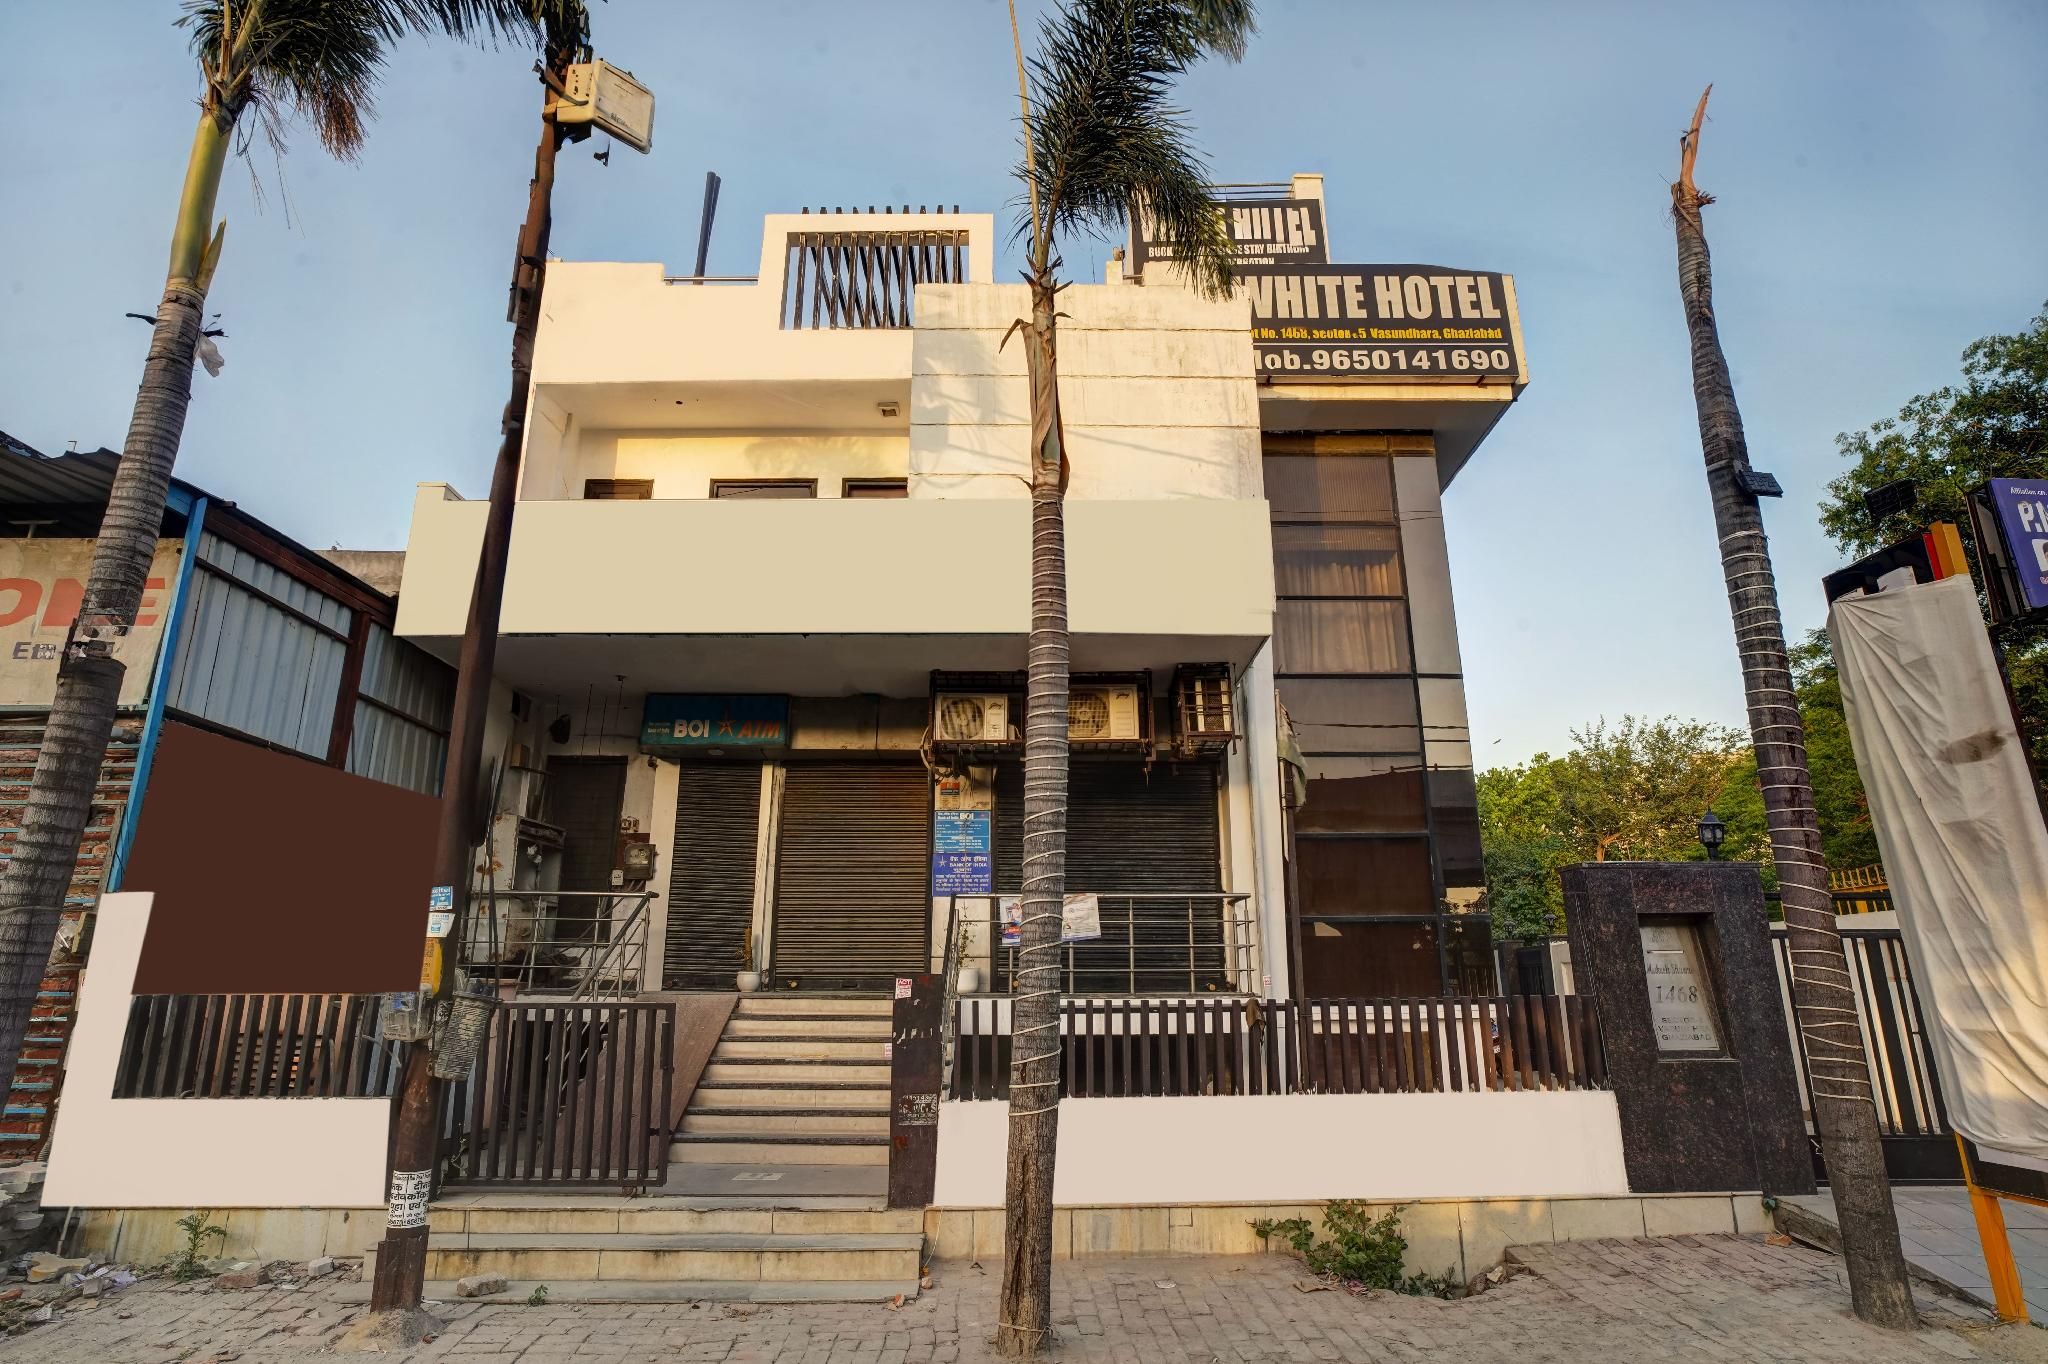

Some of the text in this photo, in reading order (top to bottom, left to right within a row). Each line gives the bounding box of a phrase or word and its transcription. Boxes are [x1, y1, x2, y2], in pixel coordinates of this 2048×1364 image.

[1243, 243, 1265, 254] STAY
[1374, 275, 1501, 319] HOTEL
[1261, 328, 1278, 339] No.
[1370, 328, 1442, 340] Vasundhara,
[1443, 327, 1503, 339] Ghaziabad
[673, 719, 710, 738] BOI
[1655, 985, 1698, 1003] 1468
